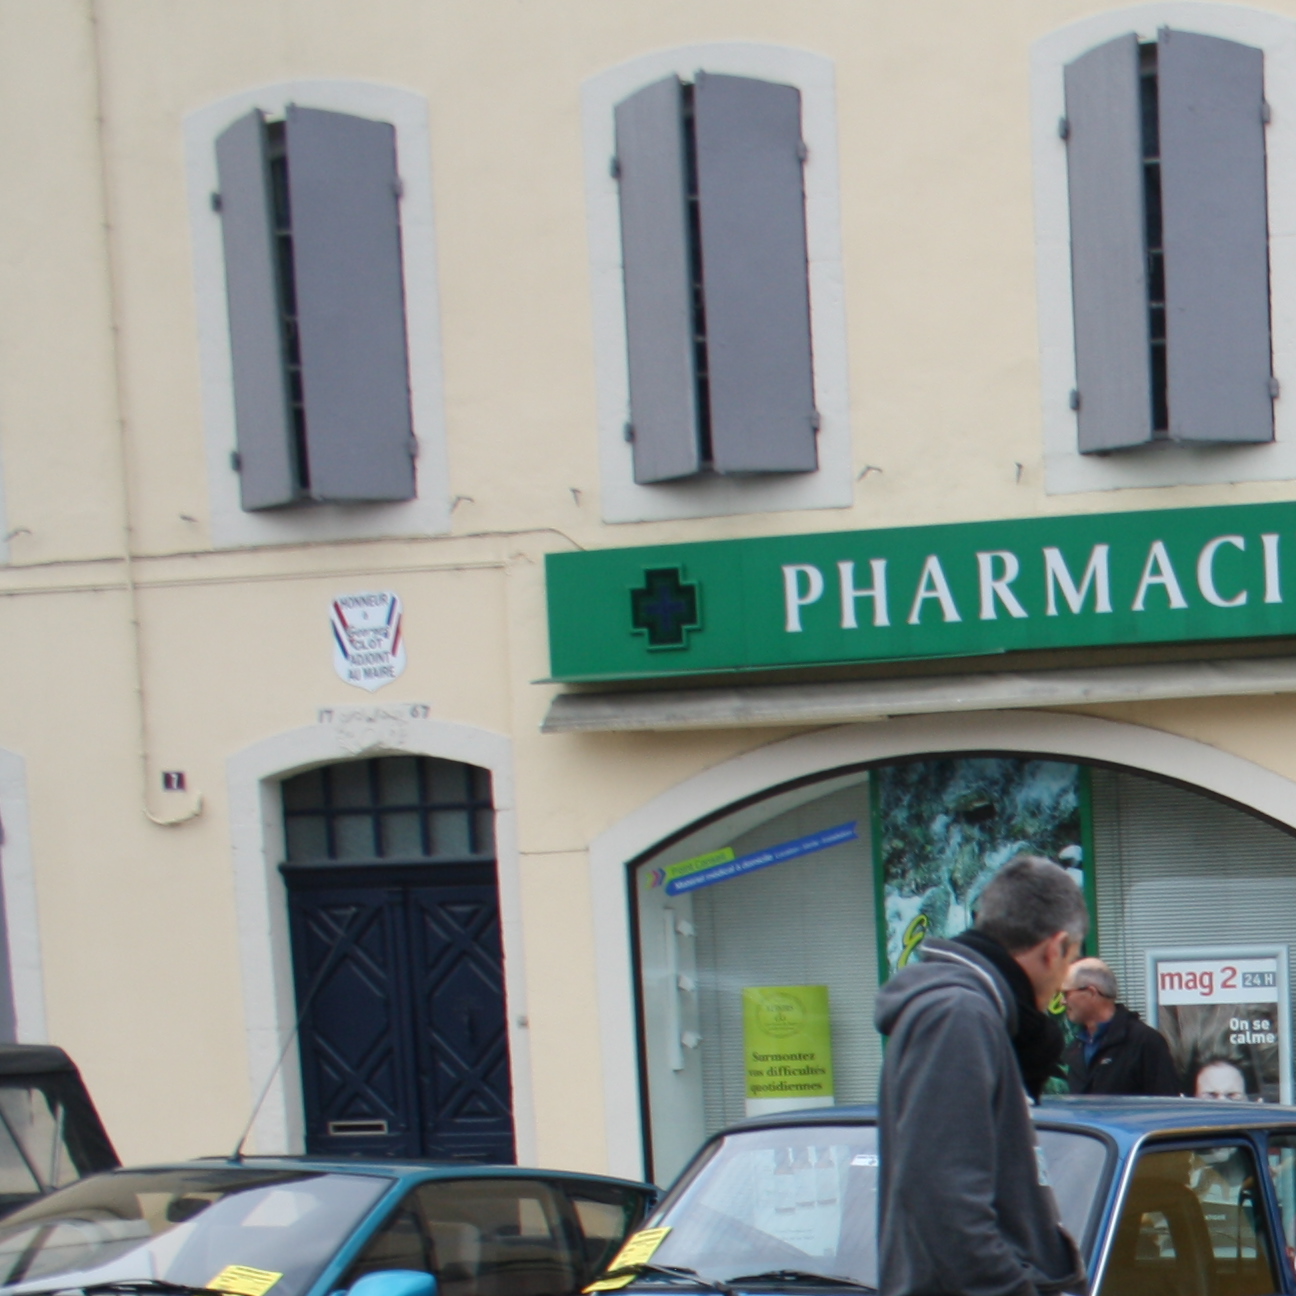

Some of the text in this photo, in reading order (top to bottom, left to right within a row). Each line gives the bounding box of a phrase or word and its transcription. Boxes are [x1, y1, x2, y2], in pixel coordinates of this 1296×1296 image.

[340, 593, 389, 608] HONNEUR
[350, 651, 390, 666] ADJOINT
[348, 665, 396, 681] AU MAIRE
[1160, 966, 1274, 997] mag 2 24 H
[1229, 1018, 1270, 1030] On se
[1229, 1031, 1276, 1044] calme
[752, 1051, 815, 1062] Surmontez
